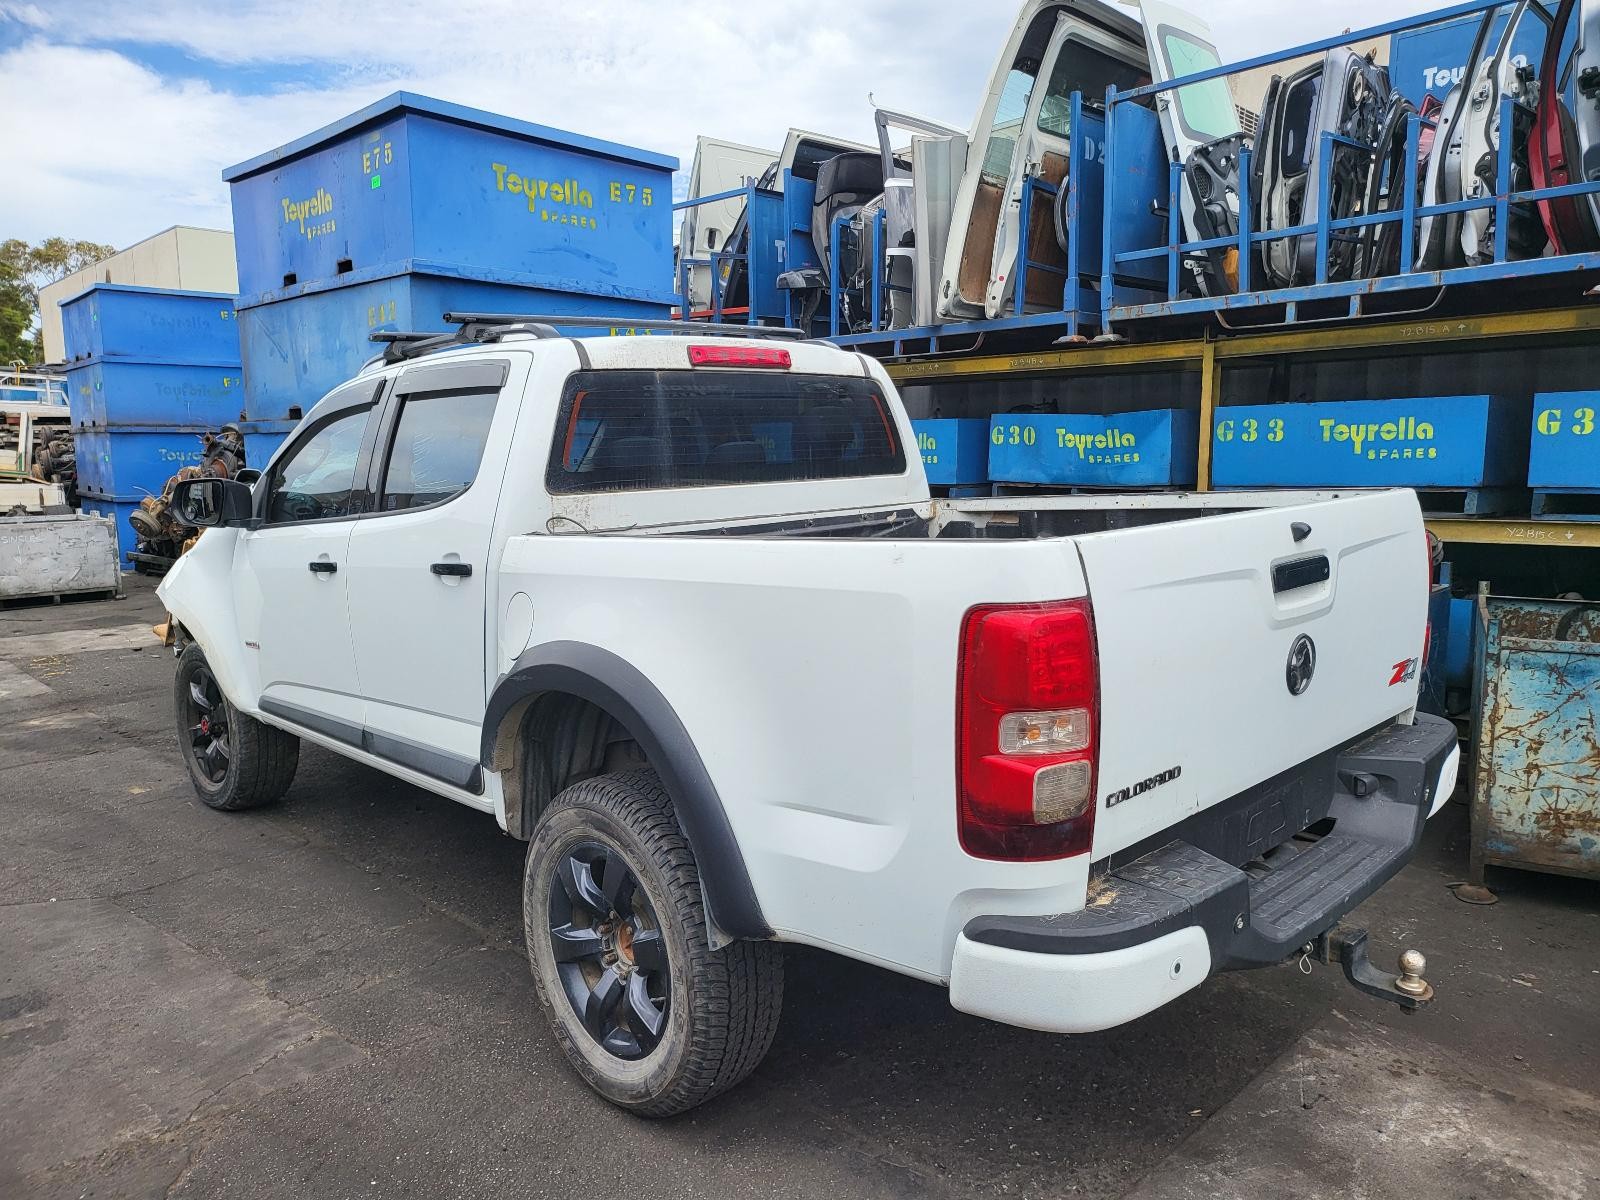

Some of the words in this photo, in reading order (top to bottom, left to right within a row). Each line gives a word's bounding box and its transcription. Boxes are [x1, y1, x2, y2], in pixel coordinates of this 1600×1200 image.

[362, 142, 393, 174] E75
[492, 162, 593, 213] Toyrolla
[609, 181, 654, 206] E75
[281, 187, 333, 235] Toyrolla
[541, 209, 597, 231] SPARES
[306, 219, 337, 241] SPARES
[220, 310, 238, 321] E7
[223, 377, 240, 388] E7
[991, 425, 1036, 446] G30
[1056, 428, 1135, 459] Toyrolla
[1216, 418, 1285, 442] G33
[1319, 416, 1434, 455] Toyrolla
[1088, 452, 1140, 464] SPARES
[1367, 447, 1437, 460] SPARES
[1105, 765, 1182, 809] COLORADO
